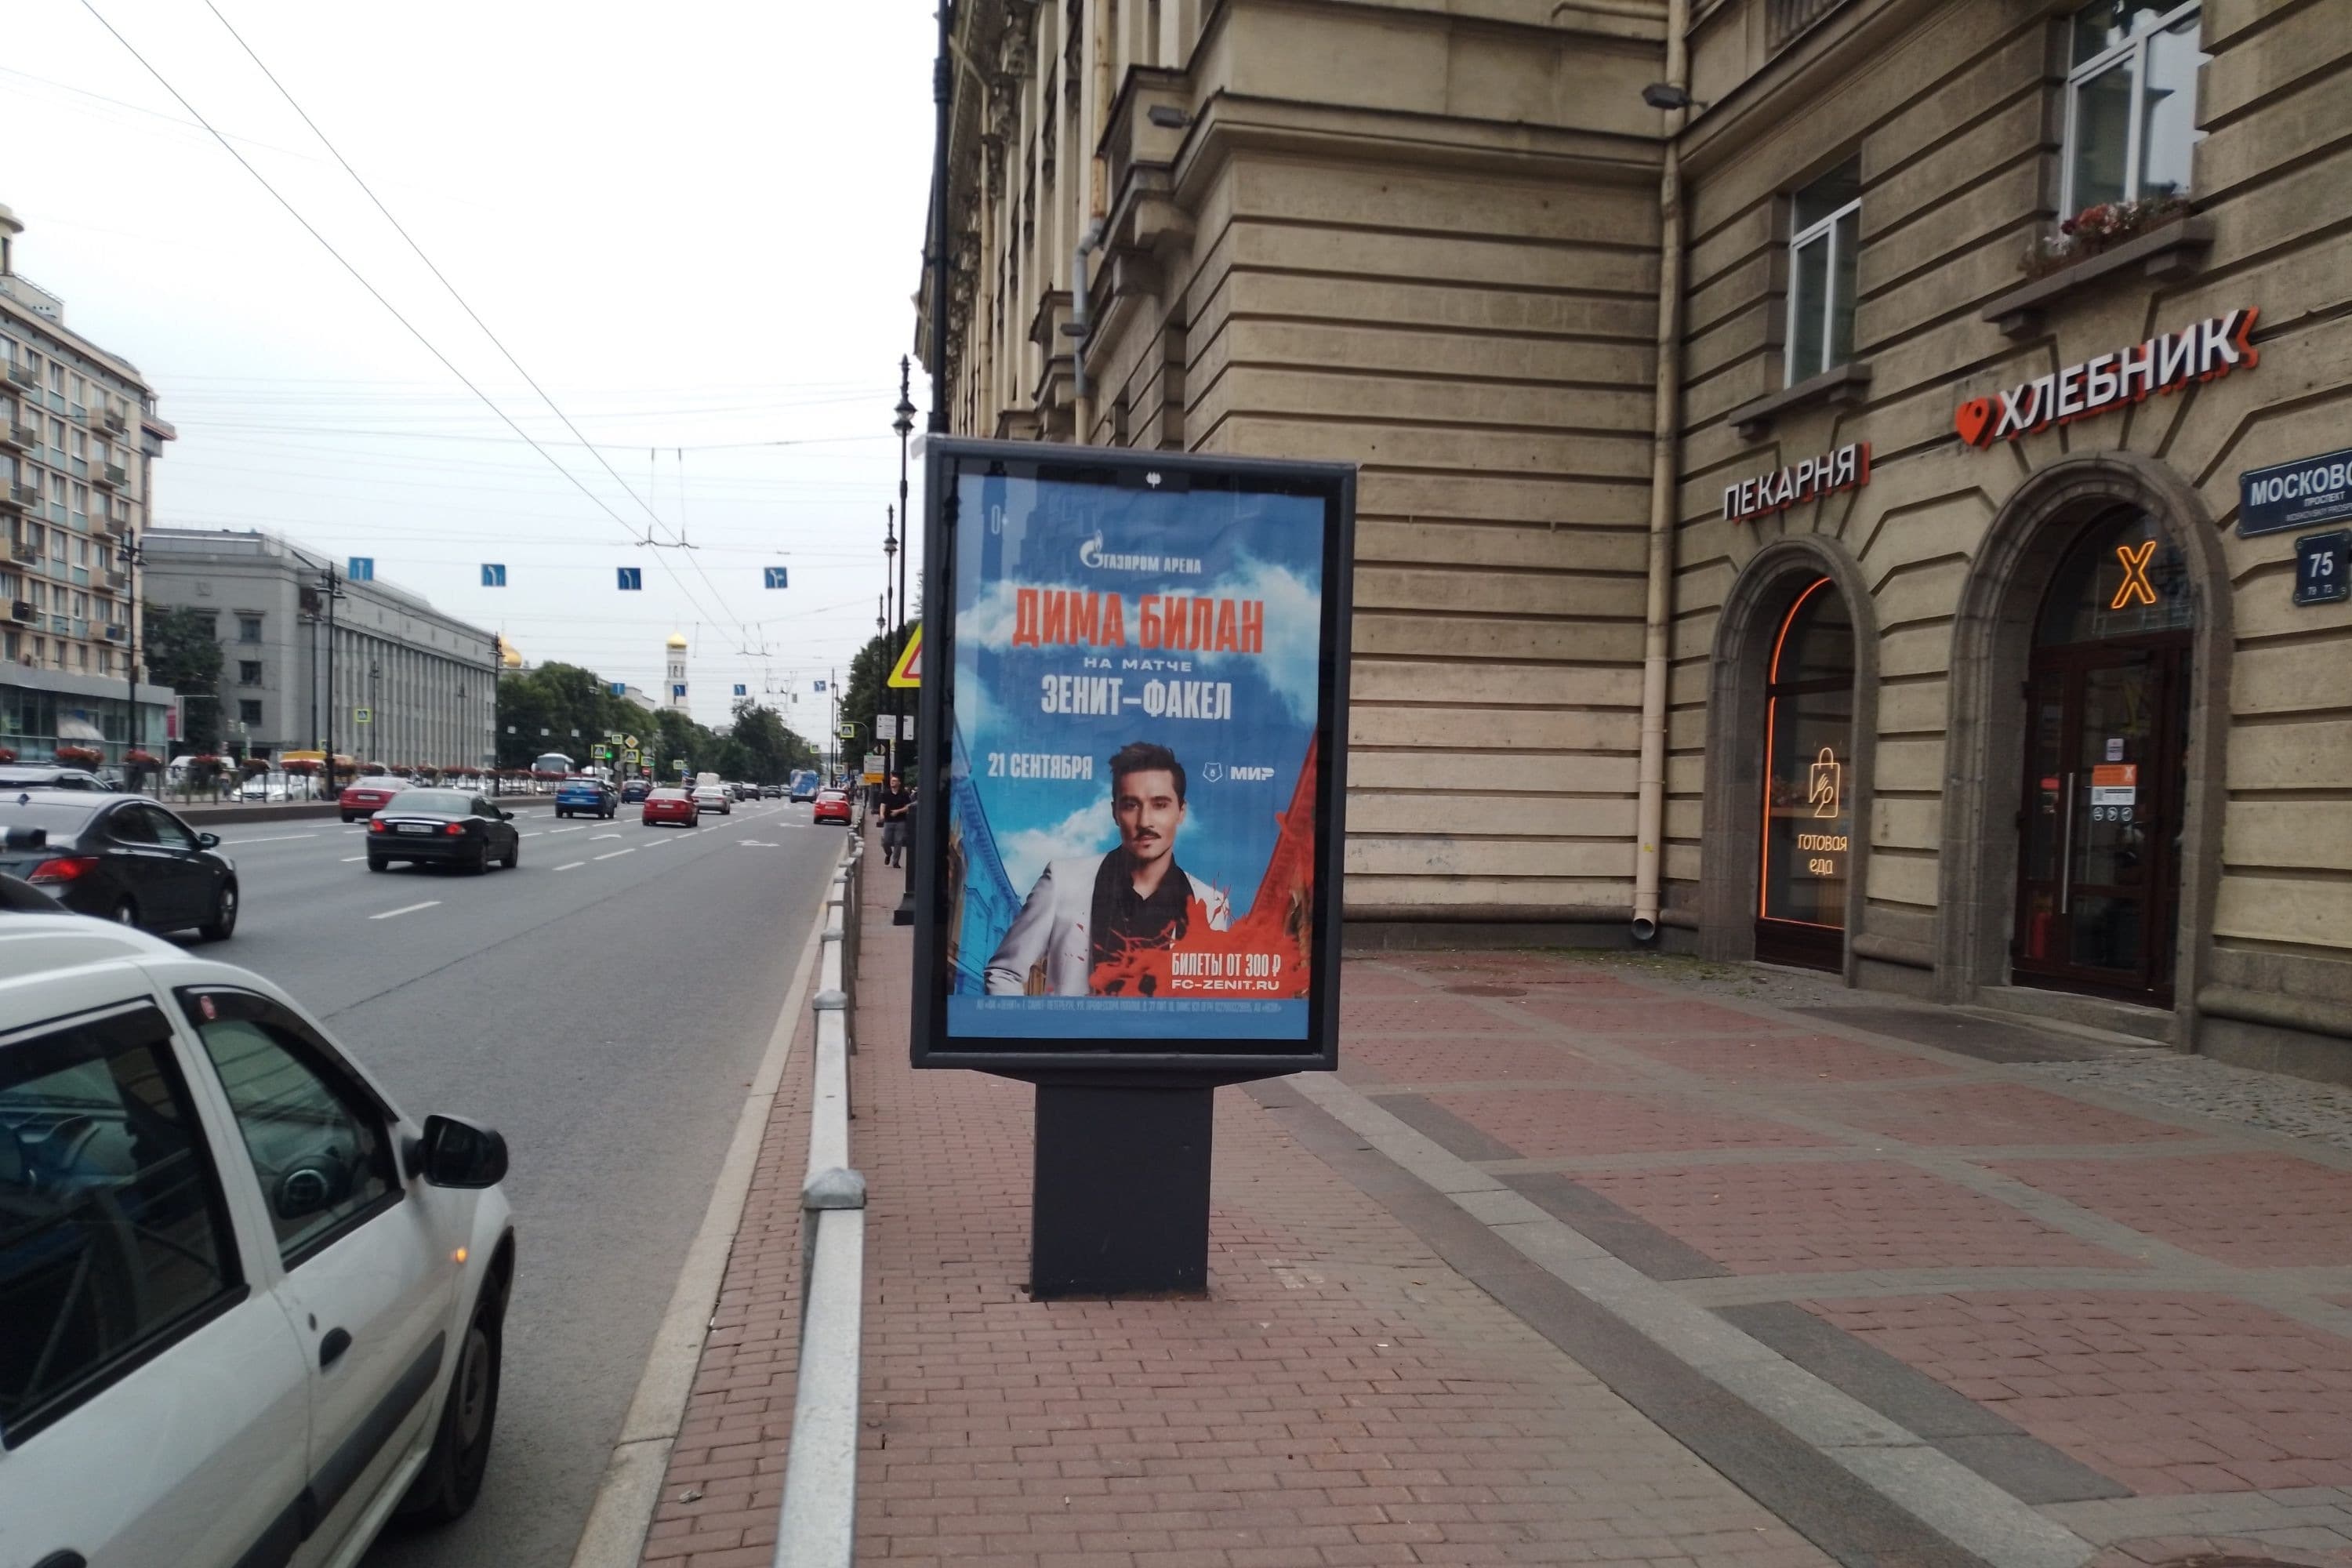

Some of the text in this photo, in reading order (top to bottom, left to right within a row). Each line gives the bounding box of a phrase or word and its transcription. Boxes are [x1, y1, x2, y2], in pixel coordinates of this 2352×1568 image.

[1994, 309, 2240, 437] ХЛЕБНИК
[1724, 443, 1857, 521] ПЕКАРНЯ
[1104, 554, 1202, 574] ГАЗПРОМ АРЕНА
[2310, 551, 2334, 578] 75
[1012, 588, 1264, 654] ДИМА БИЛАН
[1083, 657, 1192, 672] НА МАТЧЕ
[988, 752, 1093, 780] 21 СЕНТЯБРЯ
[1230, 766, 1275, 781] МИР
[1798, 834, 1848, 851] готовая
[1809, 858, 1834, 875] еда
[1171, 953, 1223, 976] БИЛЕТЫ
[1226, 953, 1242, 976] ОТ
[1245, 953, 1269, 977] 300
[1171, 979, 1280, 990] FC-ZENIT.RU
